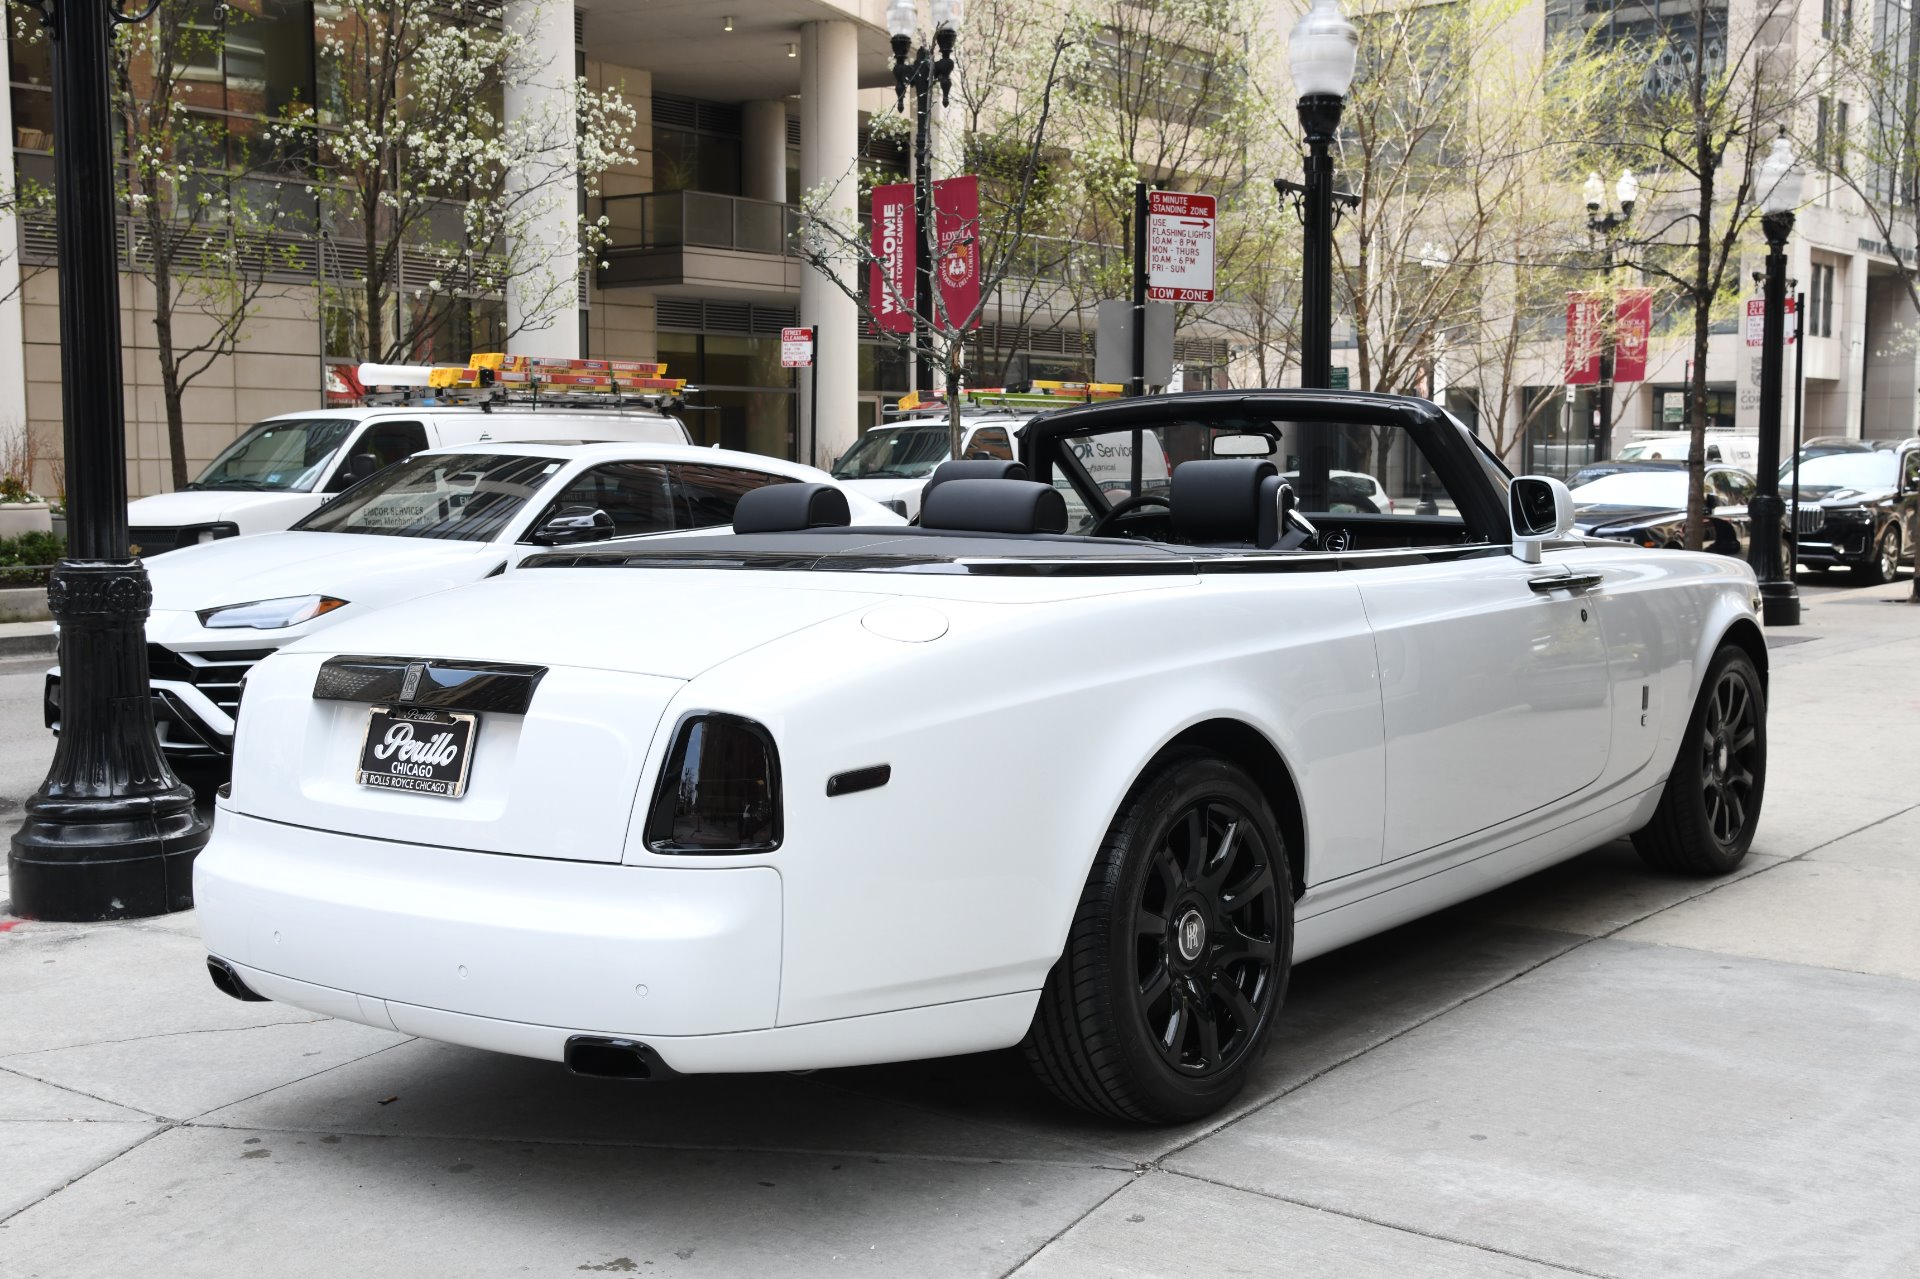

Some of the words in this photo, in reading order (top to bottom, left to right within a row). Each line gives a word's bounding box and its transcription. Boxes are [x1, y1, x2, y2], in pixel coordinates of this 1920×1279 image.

[1153, 194, 1161, 203] 15
[1162, 195, 1188, 205] MINUTE
[1153, 204, 1187, 214] STANDING
[1190, 207, 1208, 216] ZONE
[1152, 218, 1167, 226] USE
[1152, 228, 1187, 238] FLASHING
[1188, 231, 1212, 240] LIGHTS
[1152, 236, 1161, 244] 10
[1160, 237, 1172, 245] AM
[1152, 246, 1168, 254] MON
[1176, 247, 1200, 256] THURS
[1152, 255, 1160, 263] 10
[1160, 255, 1171, 263] AM
[1185, 257, 1196, 265] PM
[1152, 264, 1164, 272] FRI
[1170, 265, 1186, 273] SUN
[1151, 287, 1175, 299] TOW
[1180, 289, 1209, 300] ZONE
[1096, 443, 1132, 458] Service
[374, 722, 458, 767] Perillo
[391, 761, 433, 778] CHICAGO
[369, 774, 390, 786] ROLLS
[390, 777, 414, 789] ROYCE
[415, 780, 445, 793] CHICAGO
